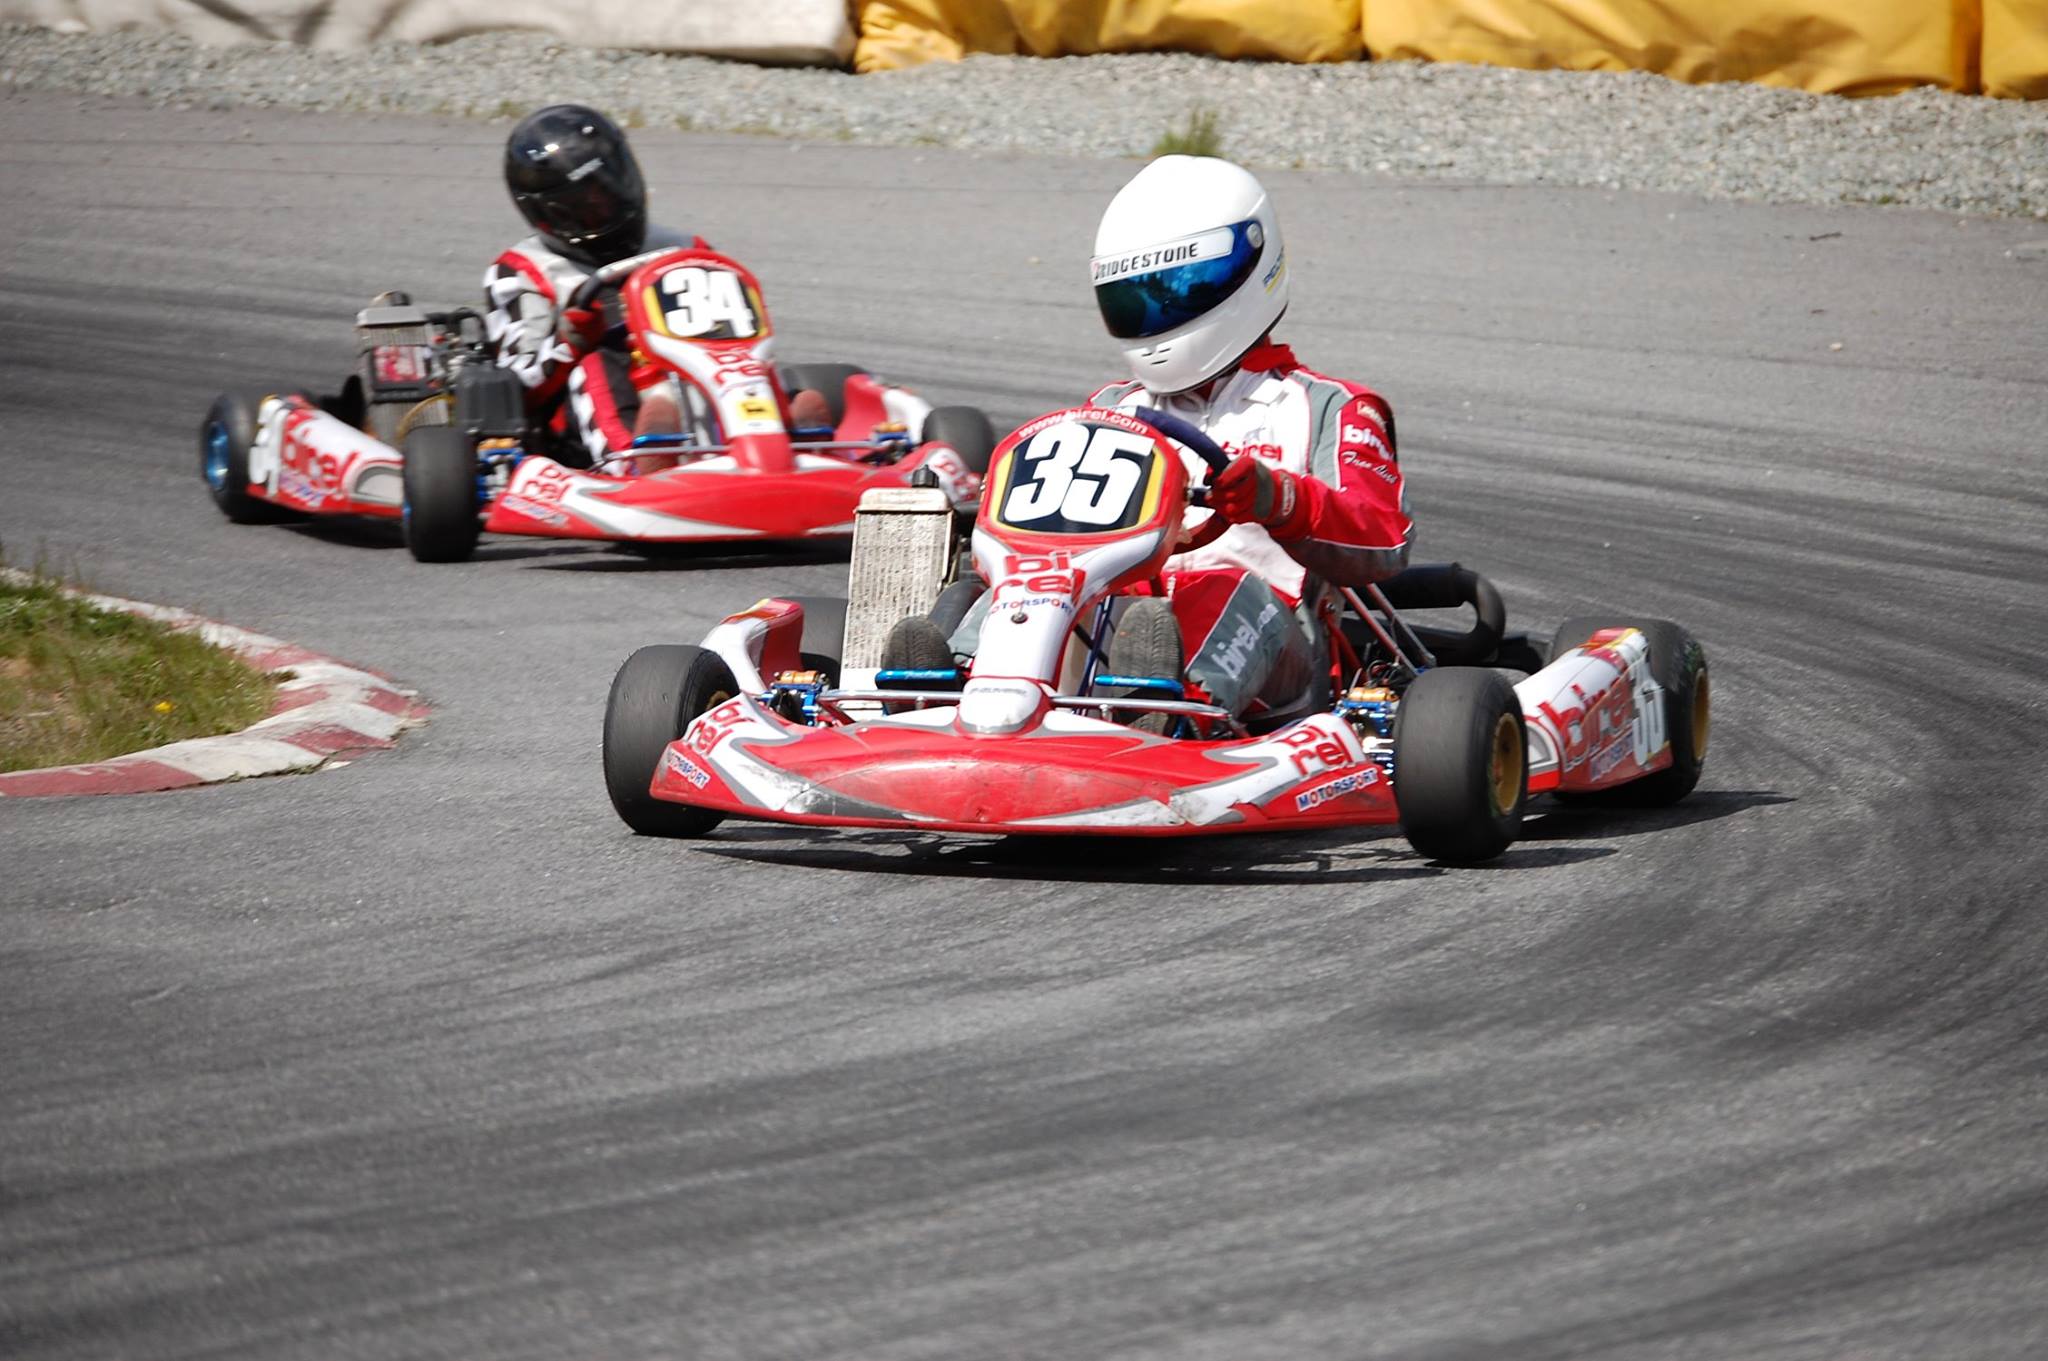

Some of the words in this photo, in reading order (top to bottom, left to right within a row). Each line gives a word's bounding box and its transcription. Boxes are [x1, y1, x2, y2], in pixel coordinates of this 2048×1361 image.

[662, 266, 757, 338] 34
[1004, 422, 1156, 526] 35
[1004, 549, 1072, 576] bi
[991, 567, 1087, 608] rel
[1289, 730, 1355, 778] rel
[1296, 768, 1379, 812] MOTORSPORT
